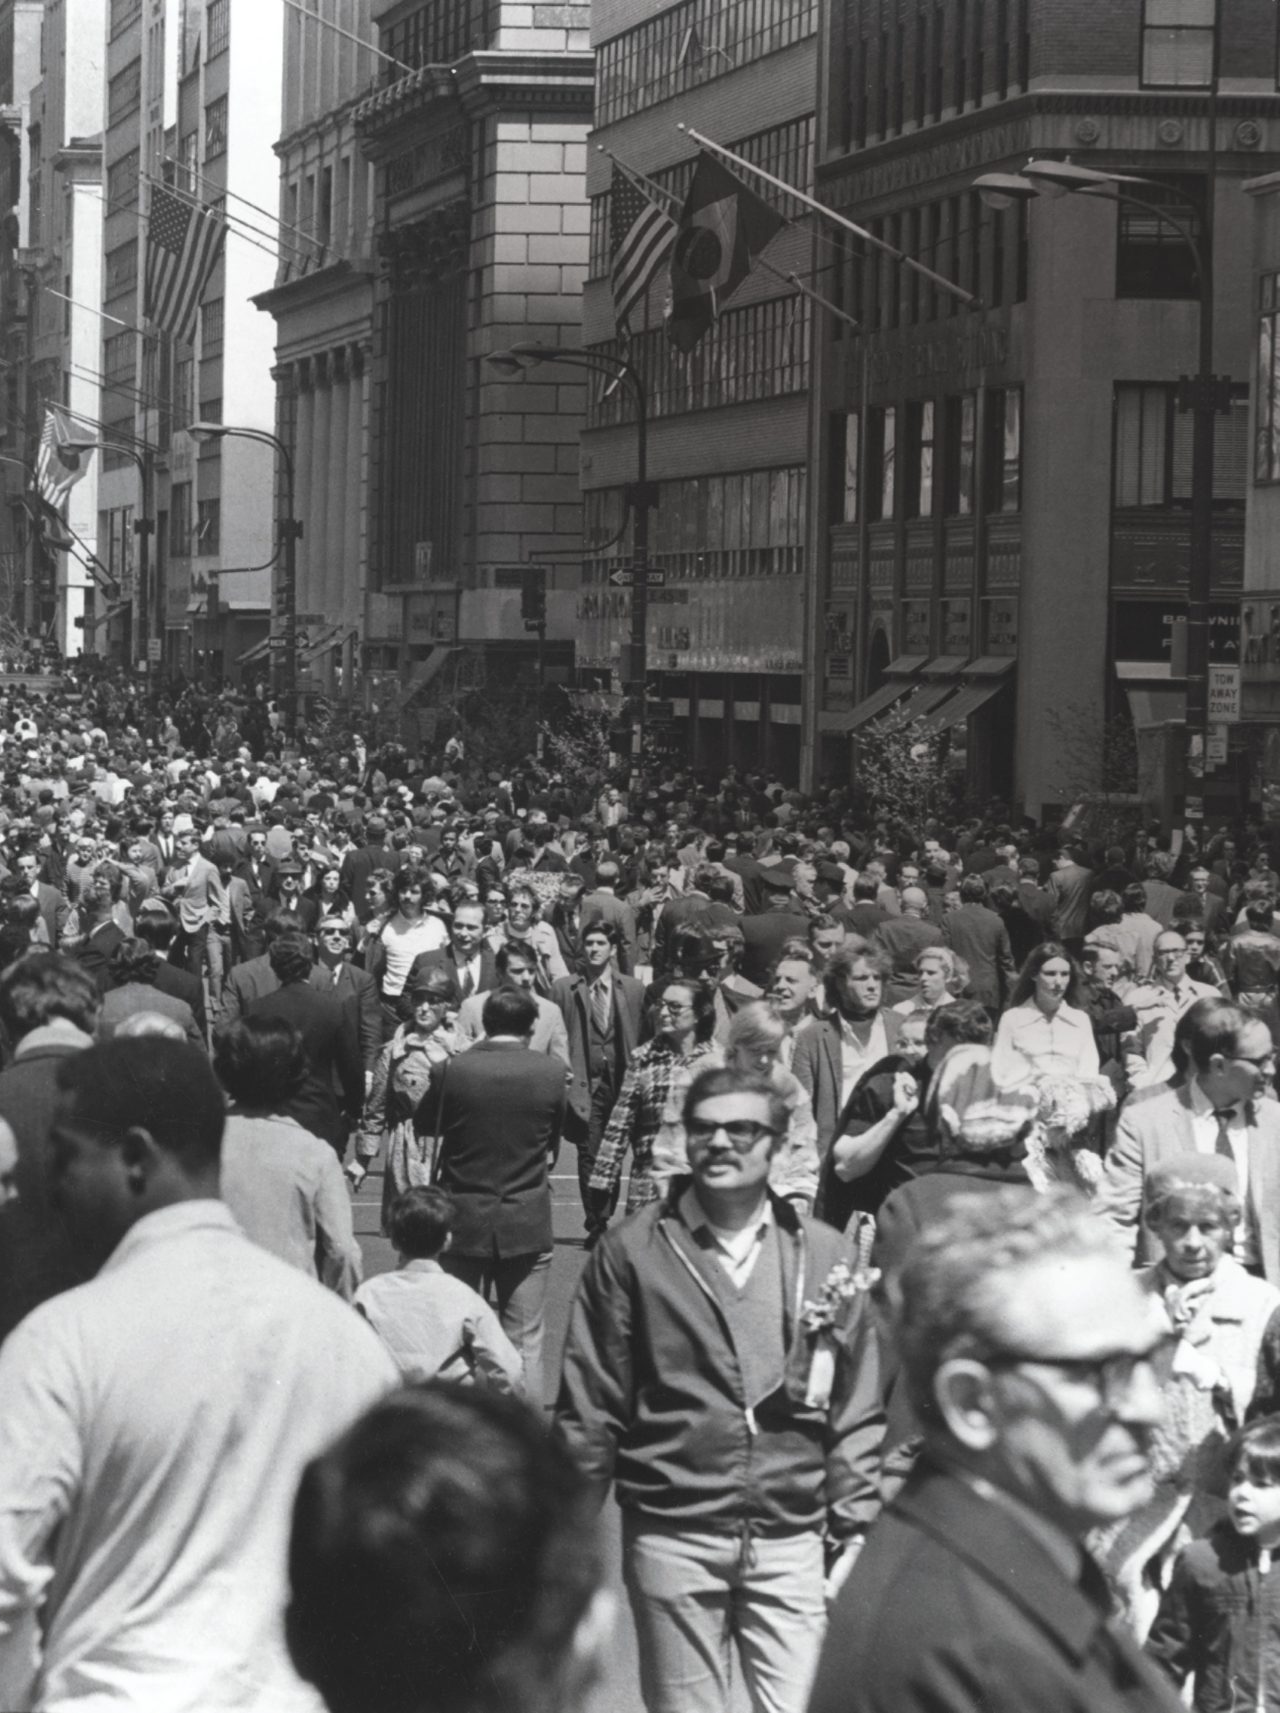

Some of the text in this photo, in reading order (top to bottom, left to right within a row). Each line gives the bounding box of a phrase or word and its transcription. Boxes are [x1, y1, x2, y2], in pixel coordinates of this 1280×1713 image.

[1214, 673, 1234, 685] TOW
[1209, 688, 1238, 699] AWAY
[1209, 702, 1237, 714] ZONE
